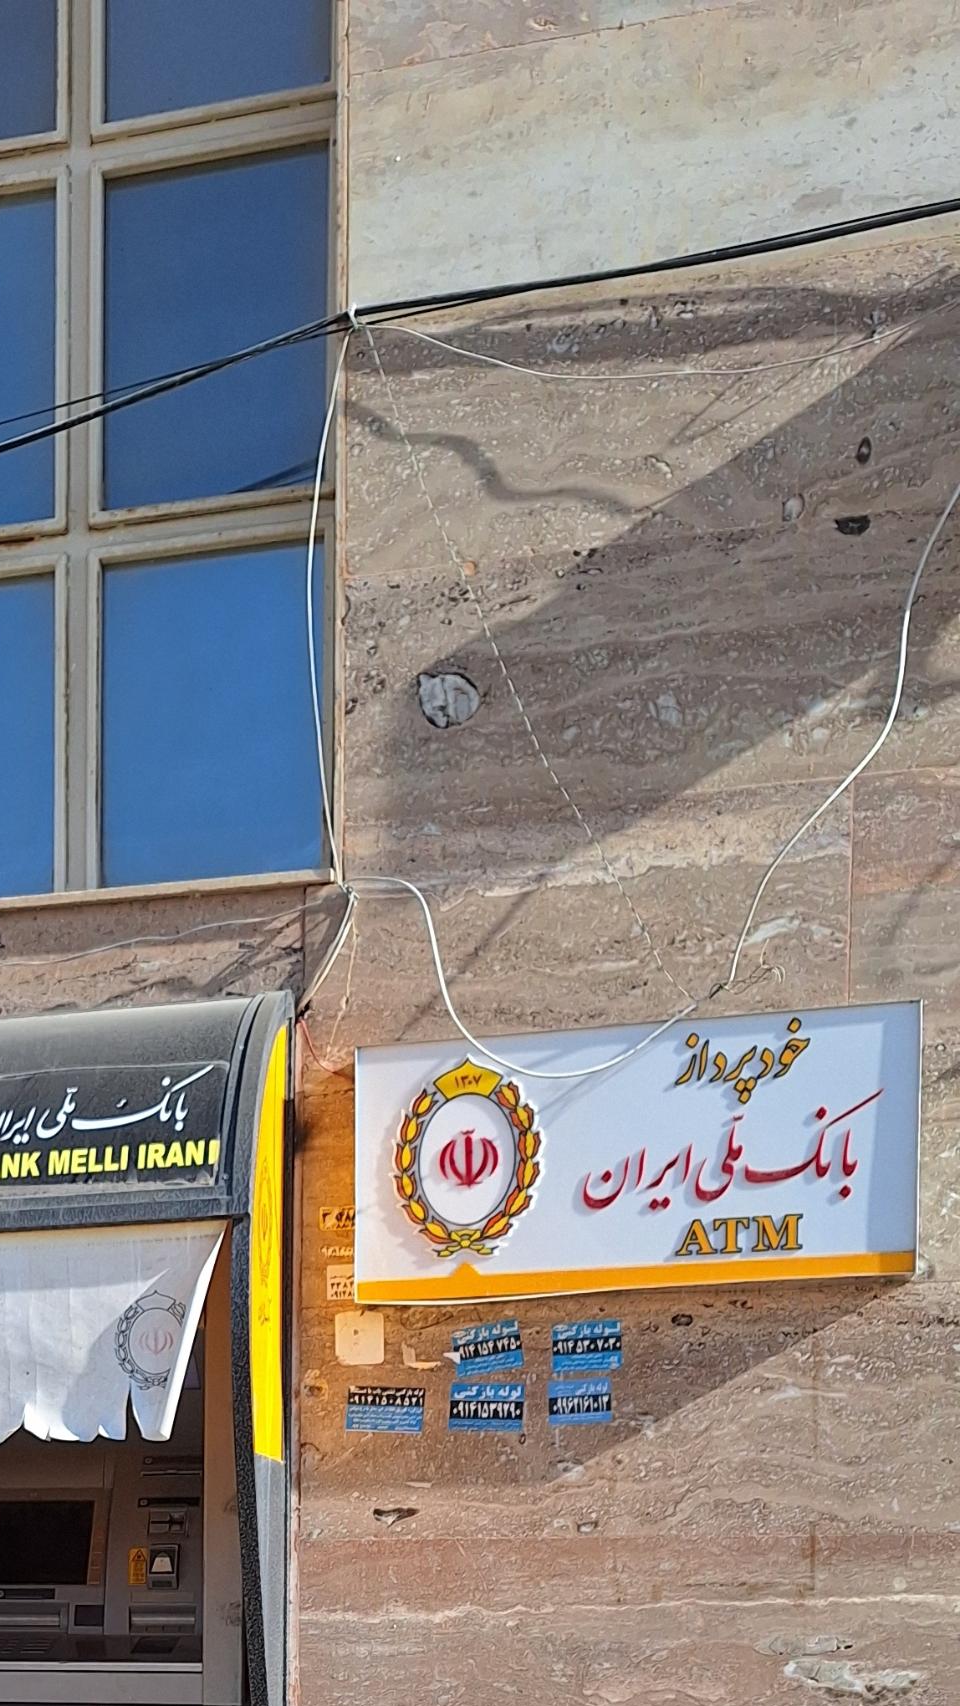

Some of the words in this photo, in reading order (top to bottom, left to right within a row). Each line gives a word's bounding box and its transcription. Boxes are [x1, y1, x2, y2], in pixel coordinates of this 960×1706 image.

[72, 1065, 215, 1132] بانک
[47, 1145, 130, 1177] MELLI
[137, 1139, 205, 1170] IRAN
[583, 1143, 694, 1211] ایران
[744, 1088, 885, 1199] بانک
[676, 1213, 804, 1257] ATM
